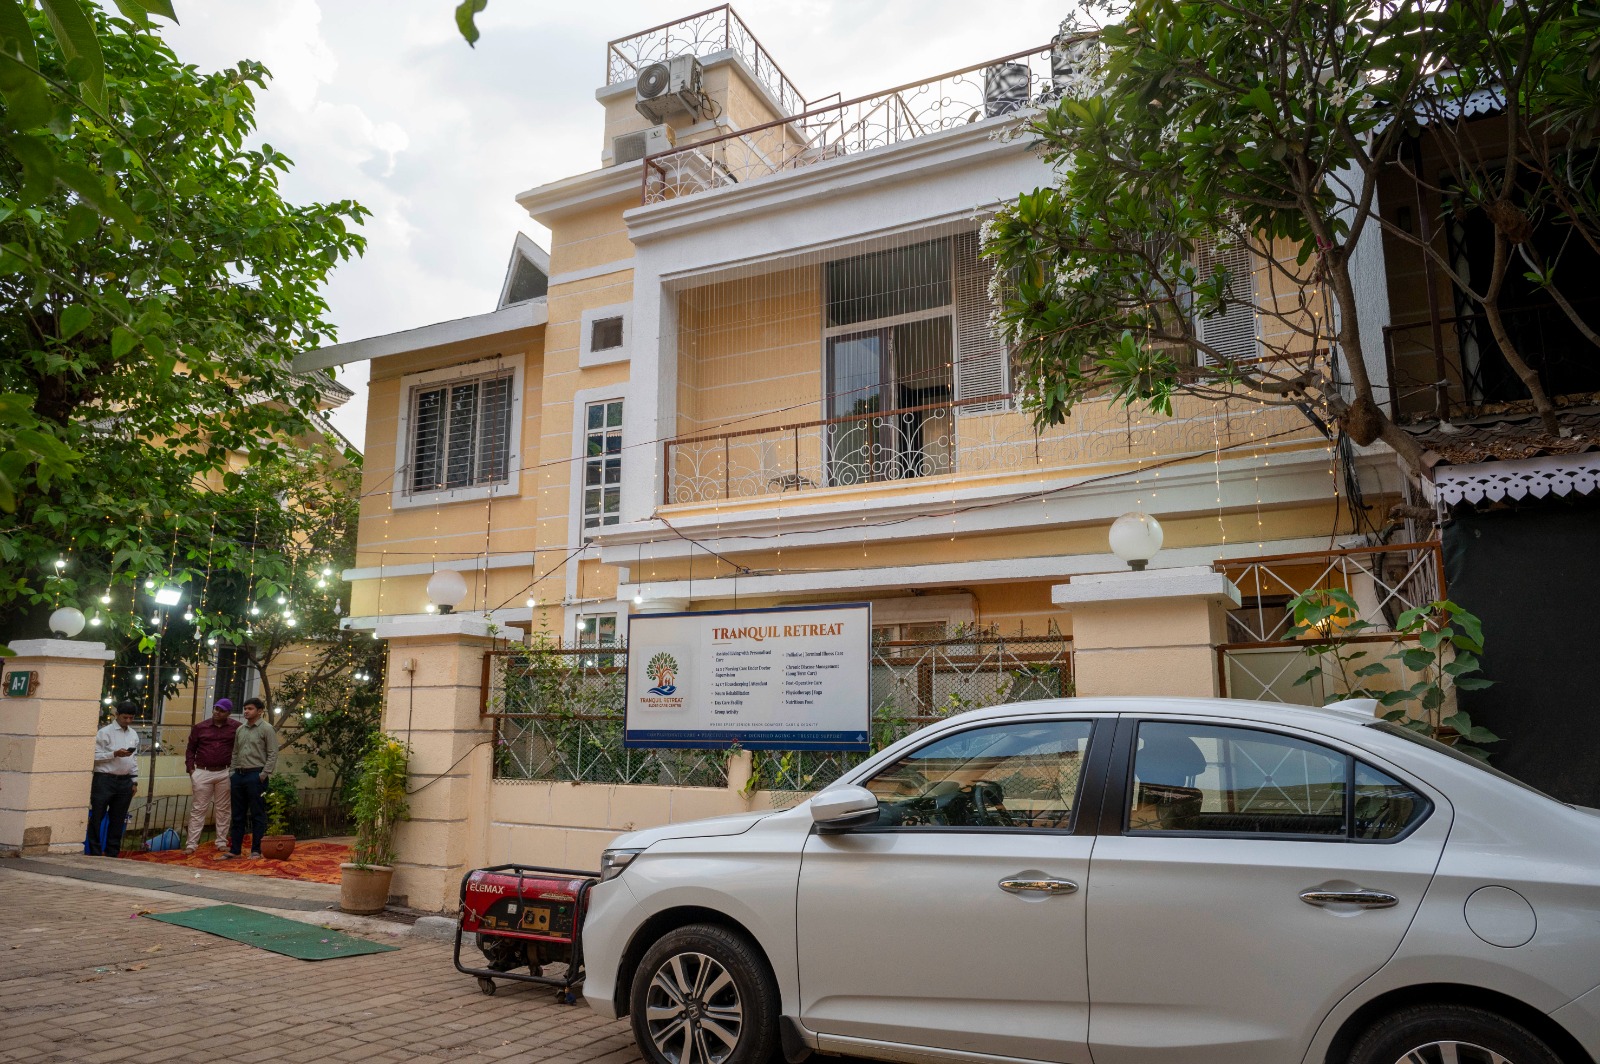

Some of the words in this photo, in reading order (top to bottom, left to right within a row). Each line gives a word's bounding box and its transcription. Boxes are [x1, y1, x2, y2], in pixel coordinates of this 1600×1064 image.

[712, 626, 780, 641] TRANQUIL
[783, 623, 844, 637] RETREAT
[12, 677, 26, 690] A-7
[470, 884, 504, 894] ELEMAX
